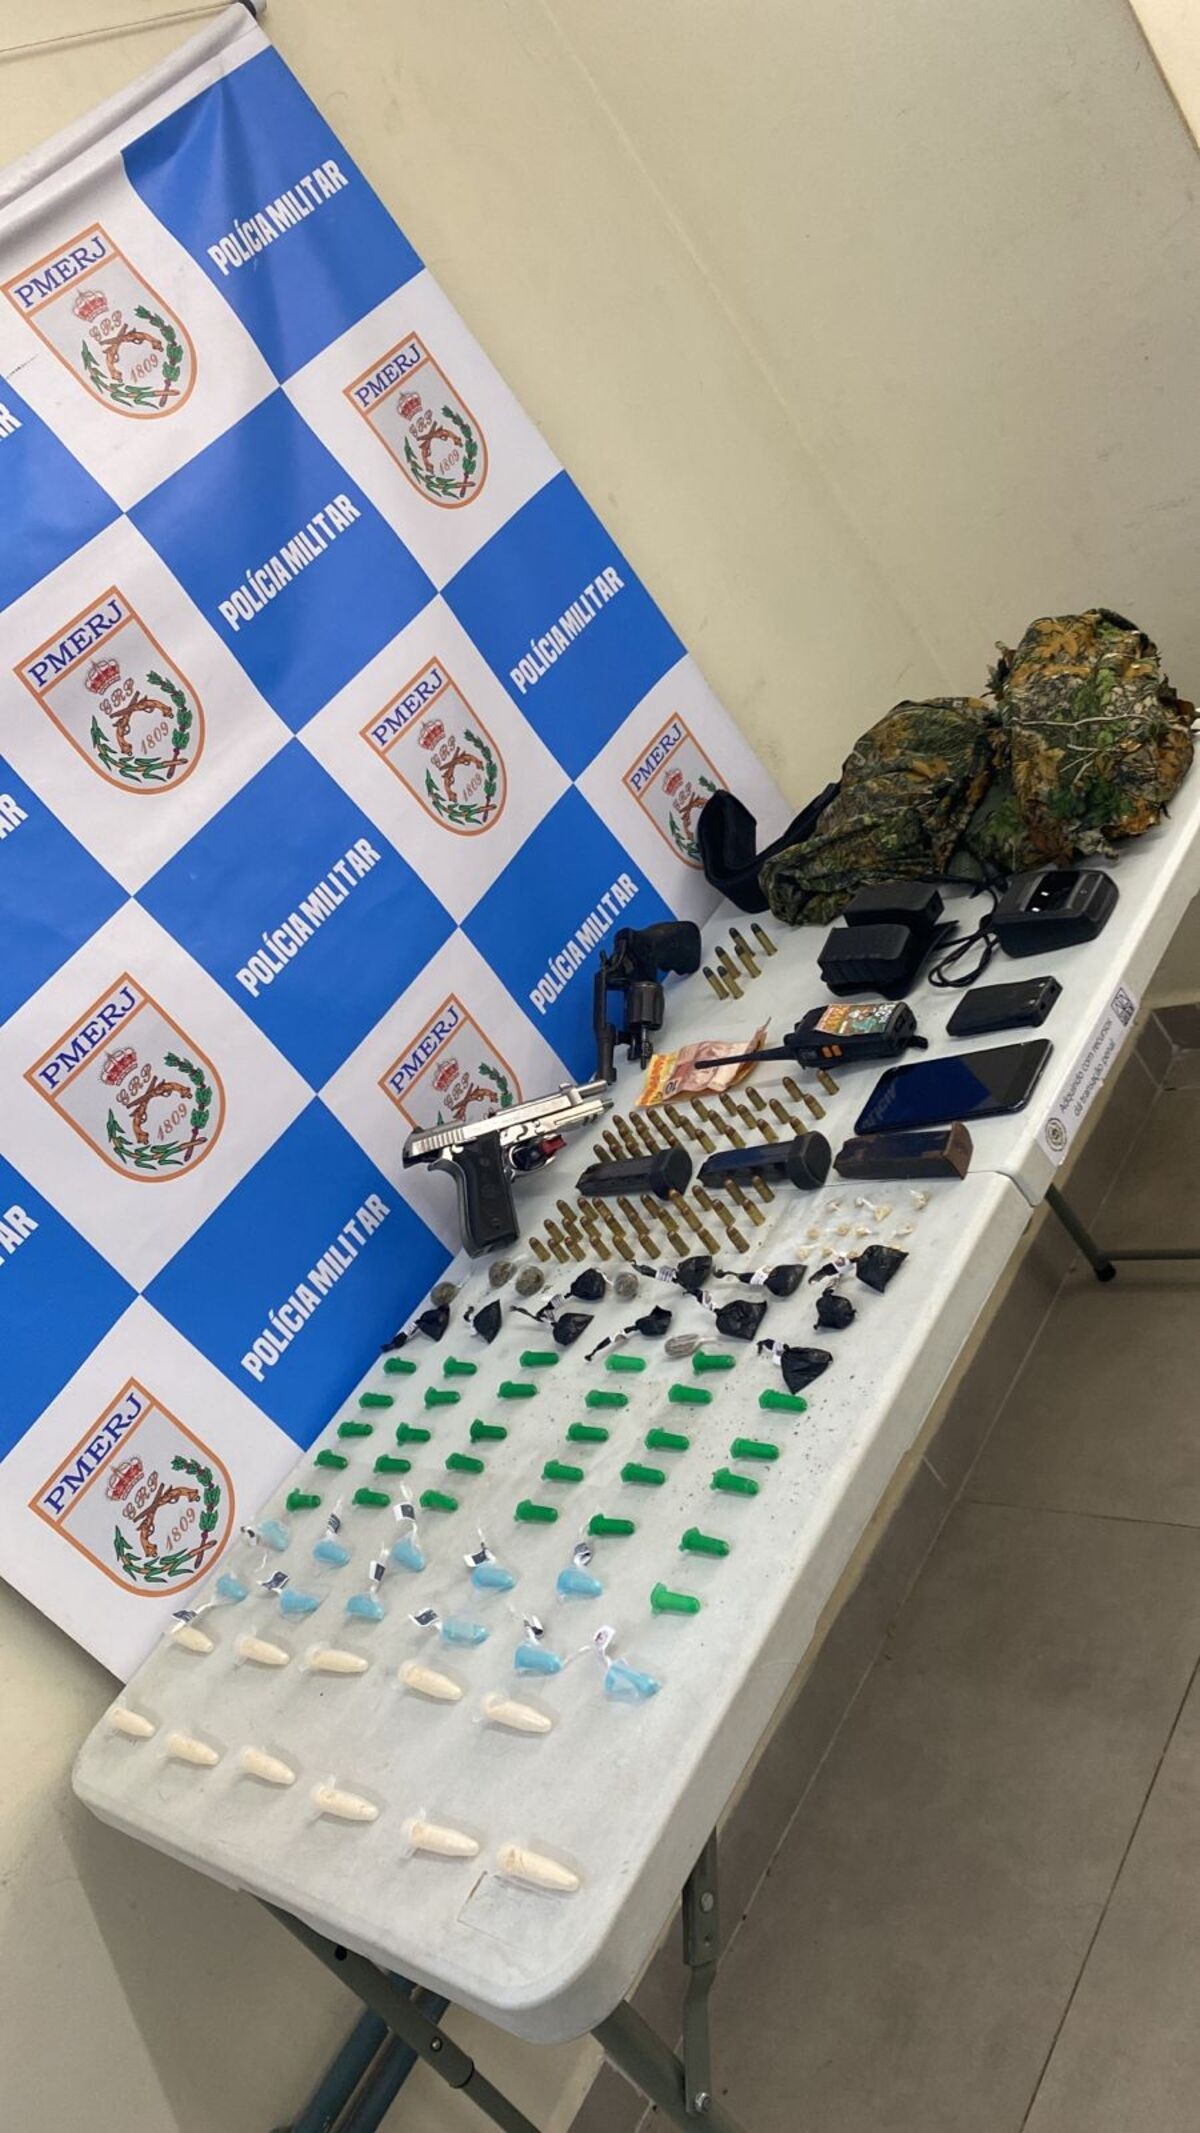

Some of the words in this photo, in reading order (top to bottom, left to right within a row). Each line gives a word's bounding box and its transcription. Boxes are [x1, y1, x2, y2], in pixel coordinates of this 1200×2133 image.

[206, 212, 280, 277] POLÍCIA
[264, 159, 349, 233] MILITAR
[14, 236, 108, 307] PMERJ
[131, 354, 159, 383] 1809
[355, 343, 421, 408] PMERJ
[440, 449, 460, 475] 1809
[217, 555, 293, 632] POLÍCIA
[279, 493, 362, 576] MILITAR
[28, 599, 123, 687] PMERJ
[509, 624, 571, 694] POLÍCIA
[558, 566, 625, 641] MILITAR
[142, 721, 169, 755] 1809
[371, 668, 443, 747] PMERJ
[629, 723, 682, 792] PMERJ
[235, 912, 315, 998] POLÍCIA
[298, 838, 381, 928] MILITAR
[529, 940, 586, 1015] POLÍCIA
[575, 873, 639, 953] MILITAR
[38, 987, 136, 1089] PMERJ
[389, 1007, 460, 1094] PMERJ
[1082, 1052, 1095, 1072] com
[157, 1103, 187, 1141] 1809
[240, 1283, 322, 1382] POLÍCIA
[307, 1194, 390, 1296] MILITAR
[44, 1393, 143, 1514] PMERJ
[166, 1508, 196, 1551] 1809
